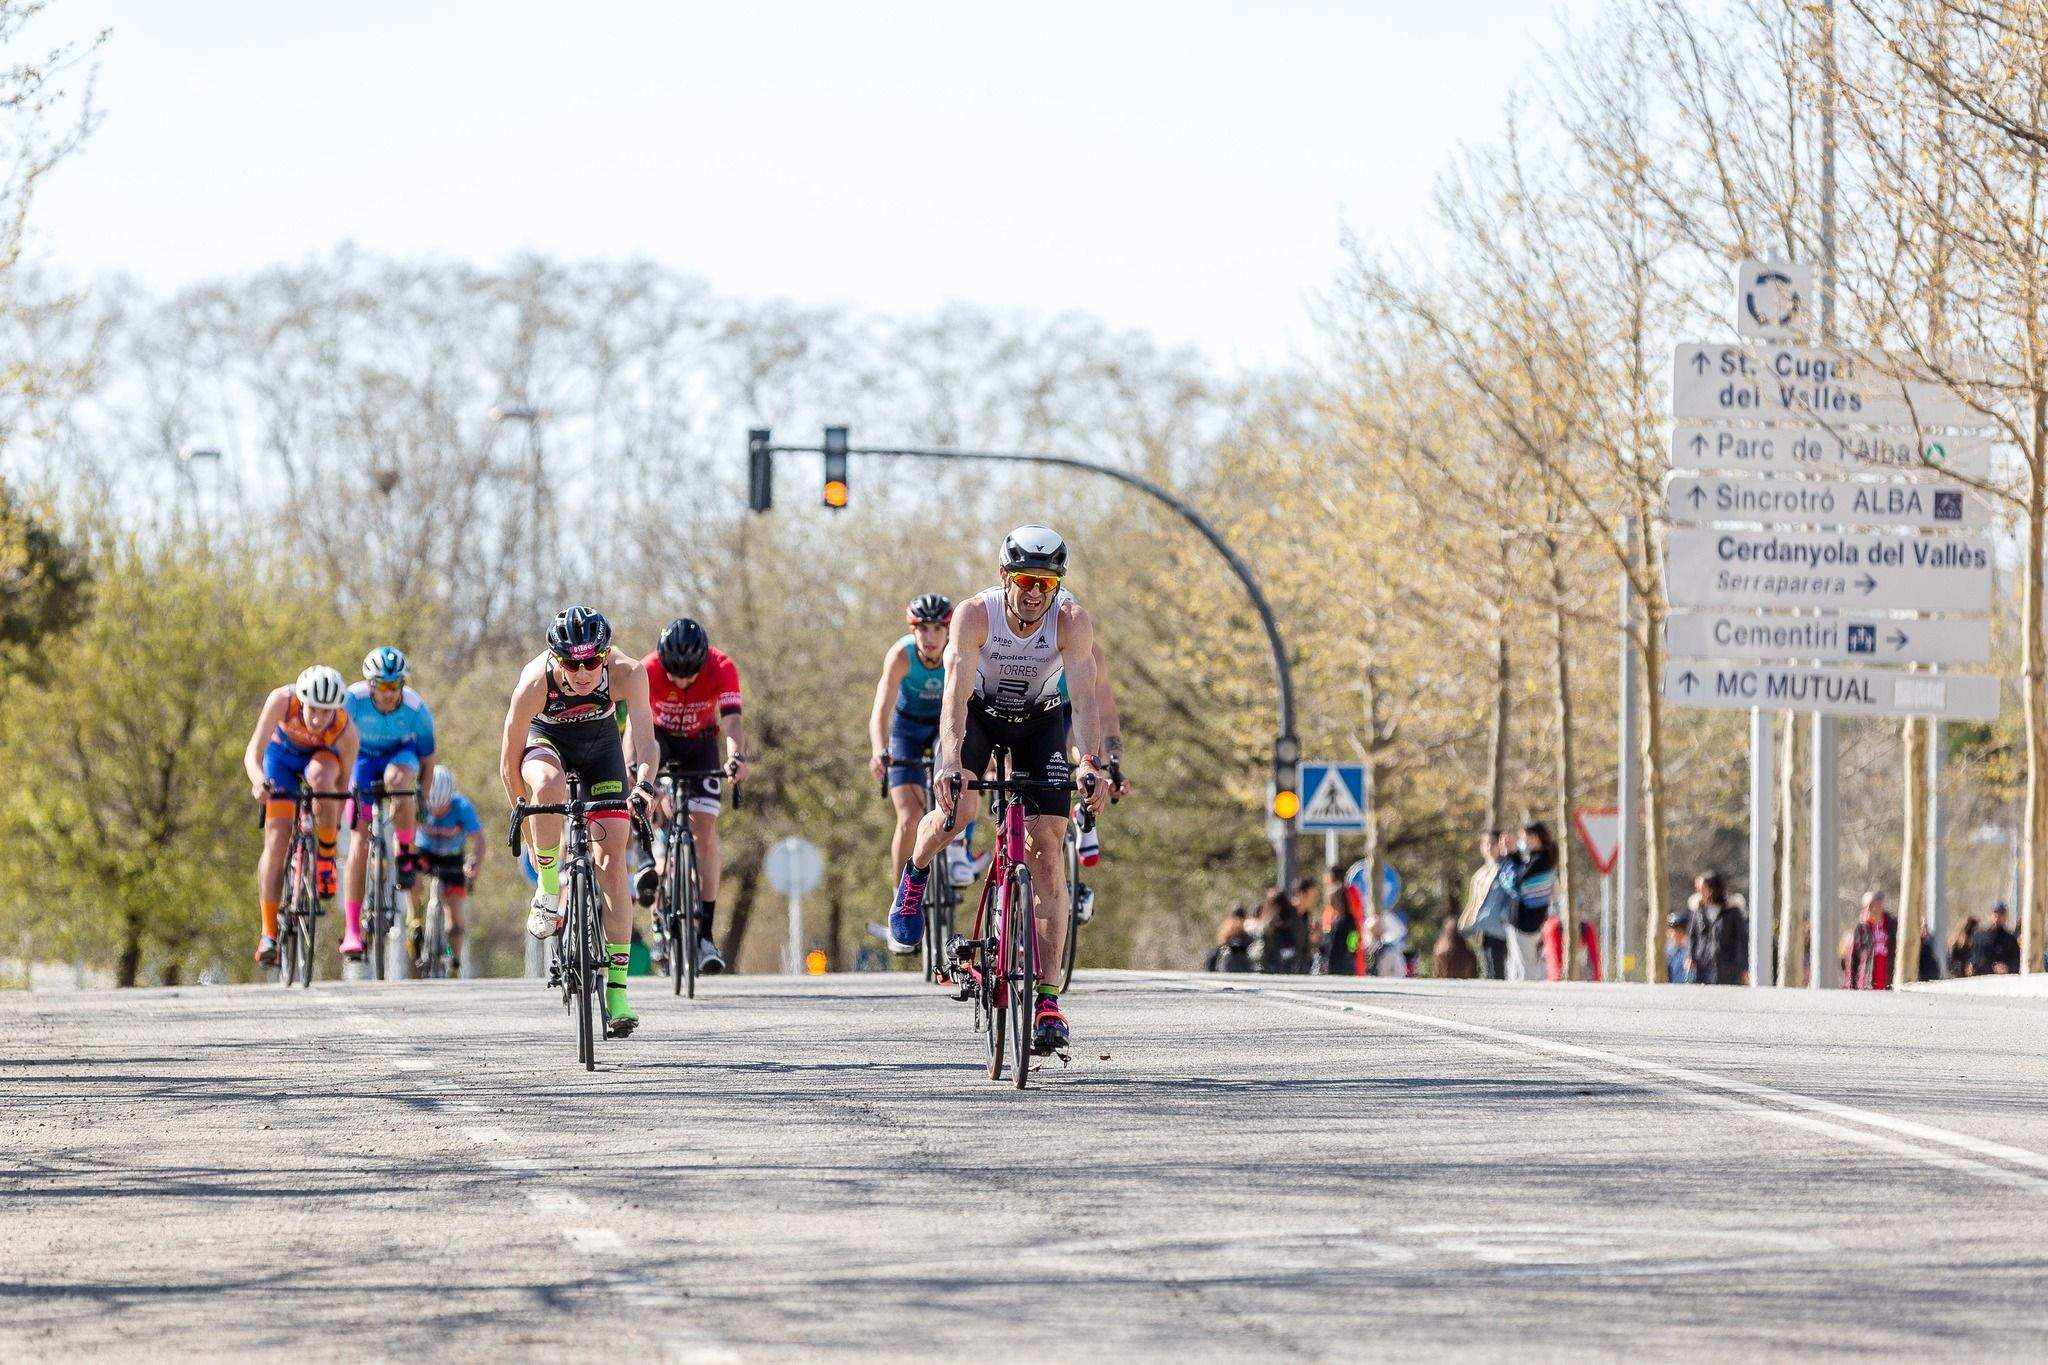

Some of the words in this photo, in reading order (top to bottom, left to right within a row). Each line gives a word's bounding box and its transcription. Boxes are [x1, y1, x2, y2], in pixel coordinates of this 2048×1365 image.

[1720, 351, 1756, 376] St.
[1719, 382, 1760, 408] del
[1717, 431, 1774, 460] Parc
[1792, 434, 1823, 462] de
[1717, 482, 1835, 513] Sincrotró
[1853, 487, 1922, 514] ALBA
[1717, 535, 1859, 568] Cerdanyola
[1867, 539, 1905, 566] del
[1913, 541, 1987, 569] Vallès
[1718, 569, 1846, 596] Serraparera
[1714, 618, 1838, 649] Cementiri
[999, 664, 1038, 678] TORRES
[1716, 671, 1758, 698] MC
[1766, 672, 1878, 705] MUTUAL
